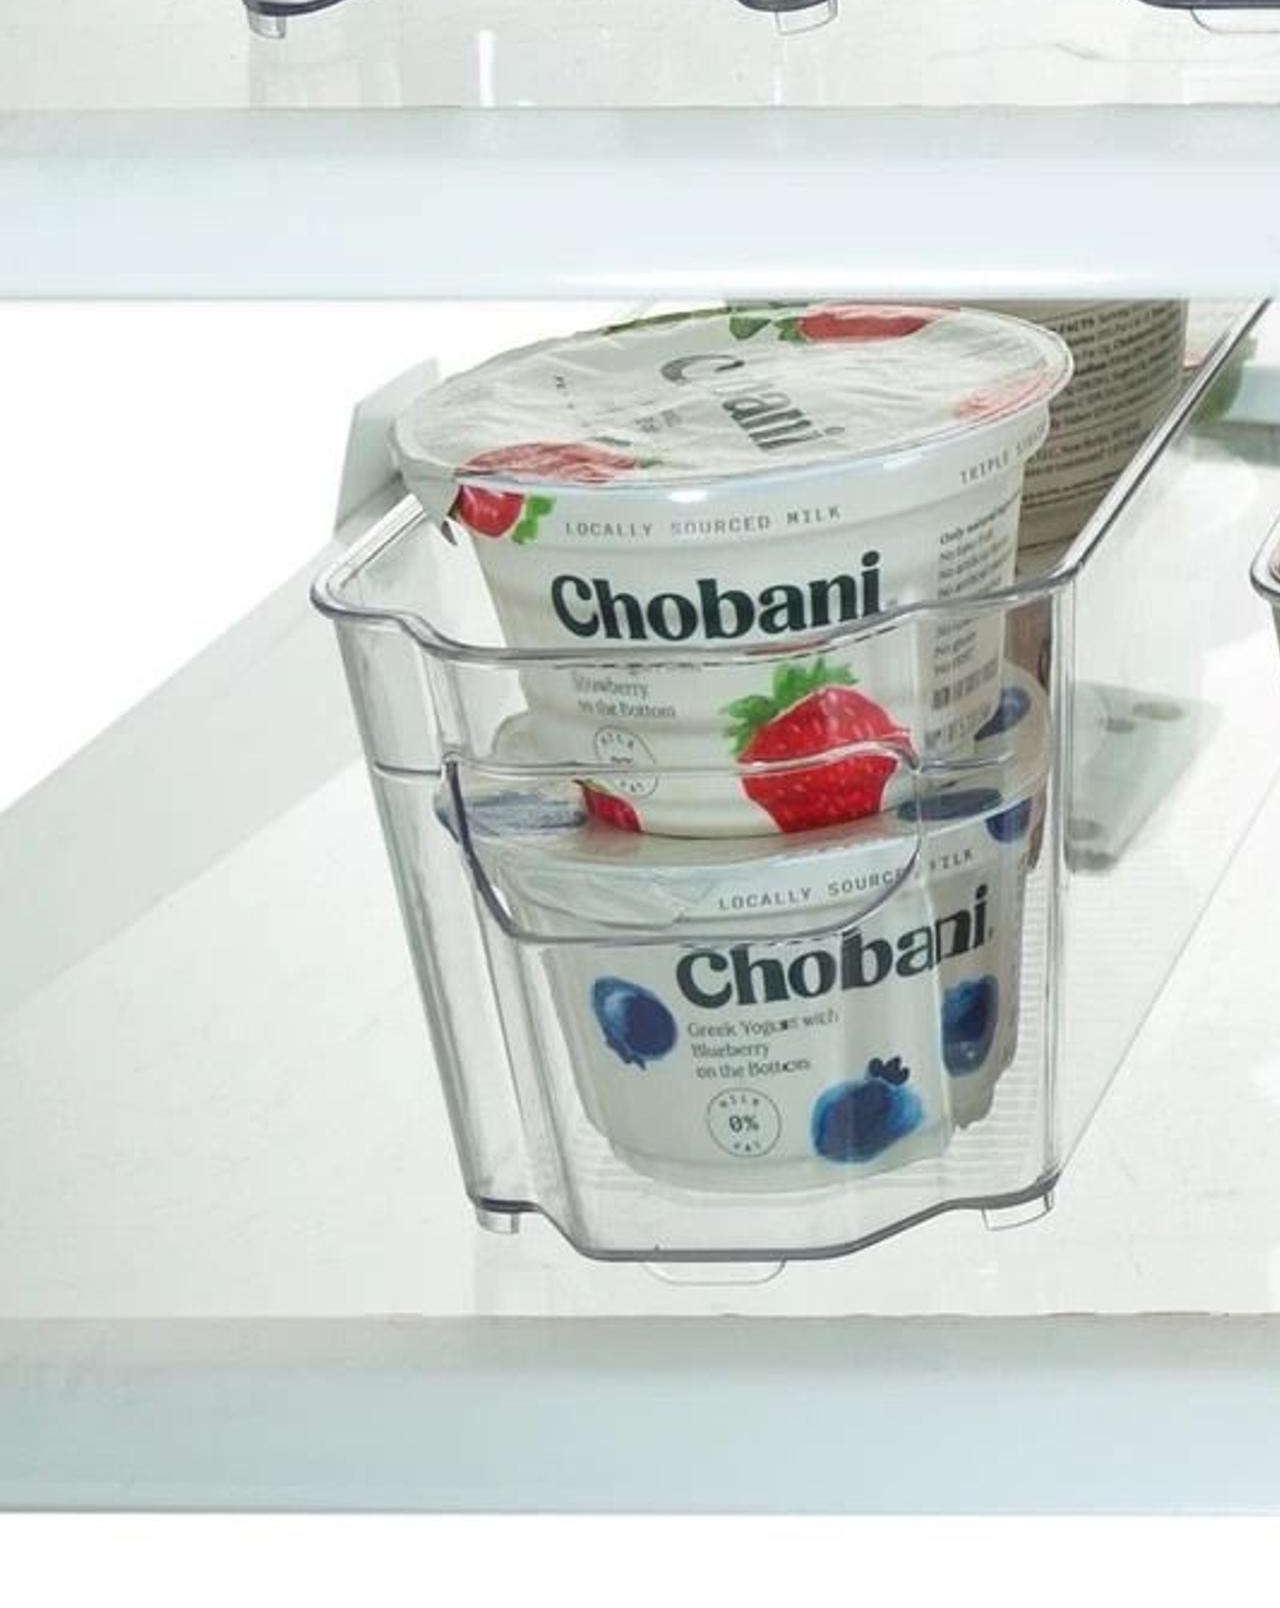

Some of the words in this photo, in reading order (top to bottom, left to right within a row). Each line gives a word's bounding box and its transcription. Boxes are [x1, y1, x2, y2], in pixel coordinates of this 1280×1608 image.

[565, 519, 655, 539] LOCALLY
[669, 514, 773, 537] SOURCED
[786, 505, 842, 525] MILK
[551, 549, 887, 643] Chobani
[718, 886, 813, 912] LOCALLY
[675, 883, 990, 1010] Chobani
[687, 1021, 738, 1038] Greek
[728, 1114, 760, 1133] 0%
